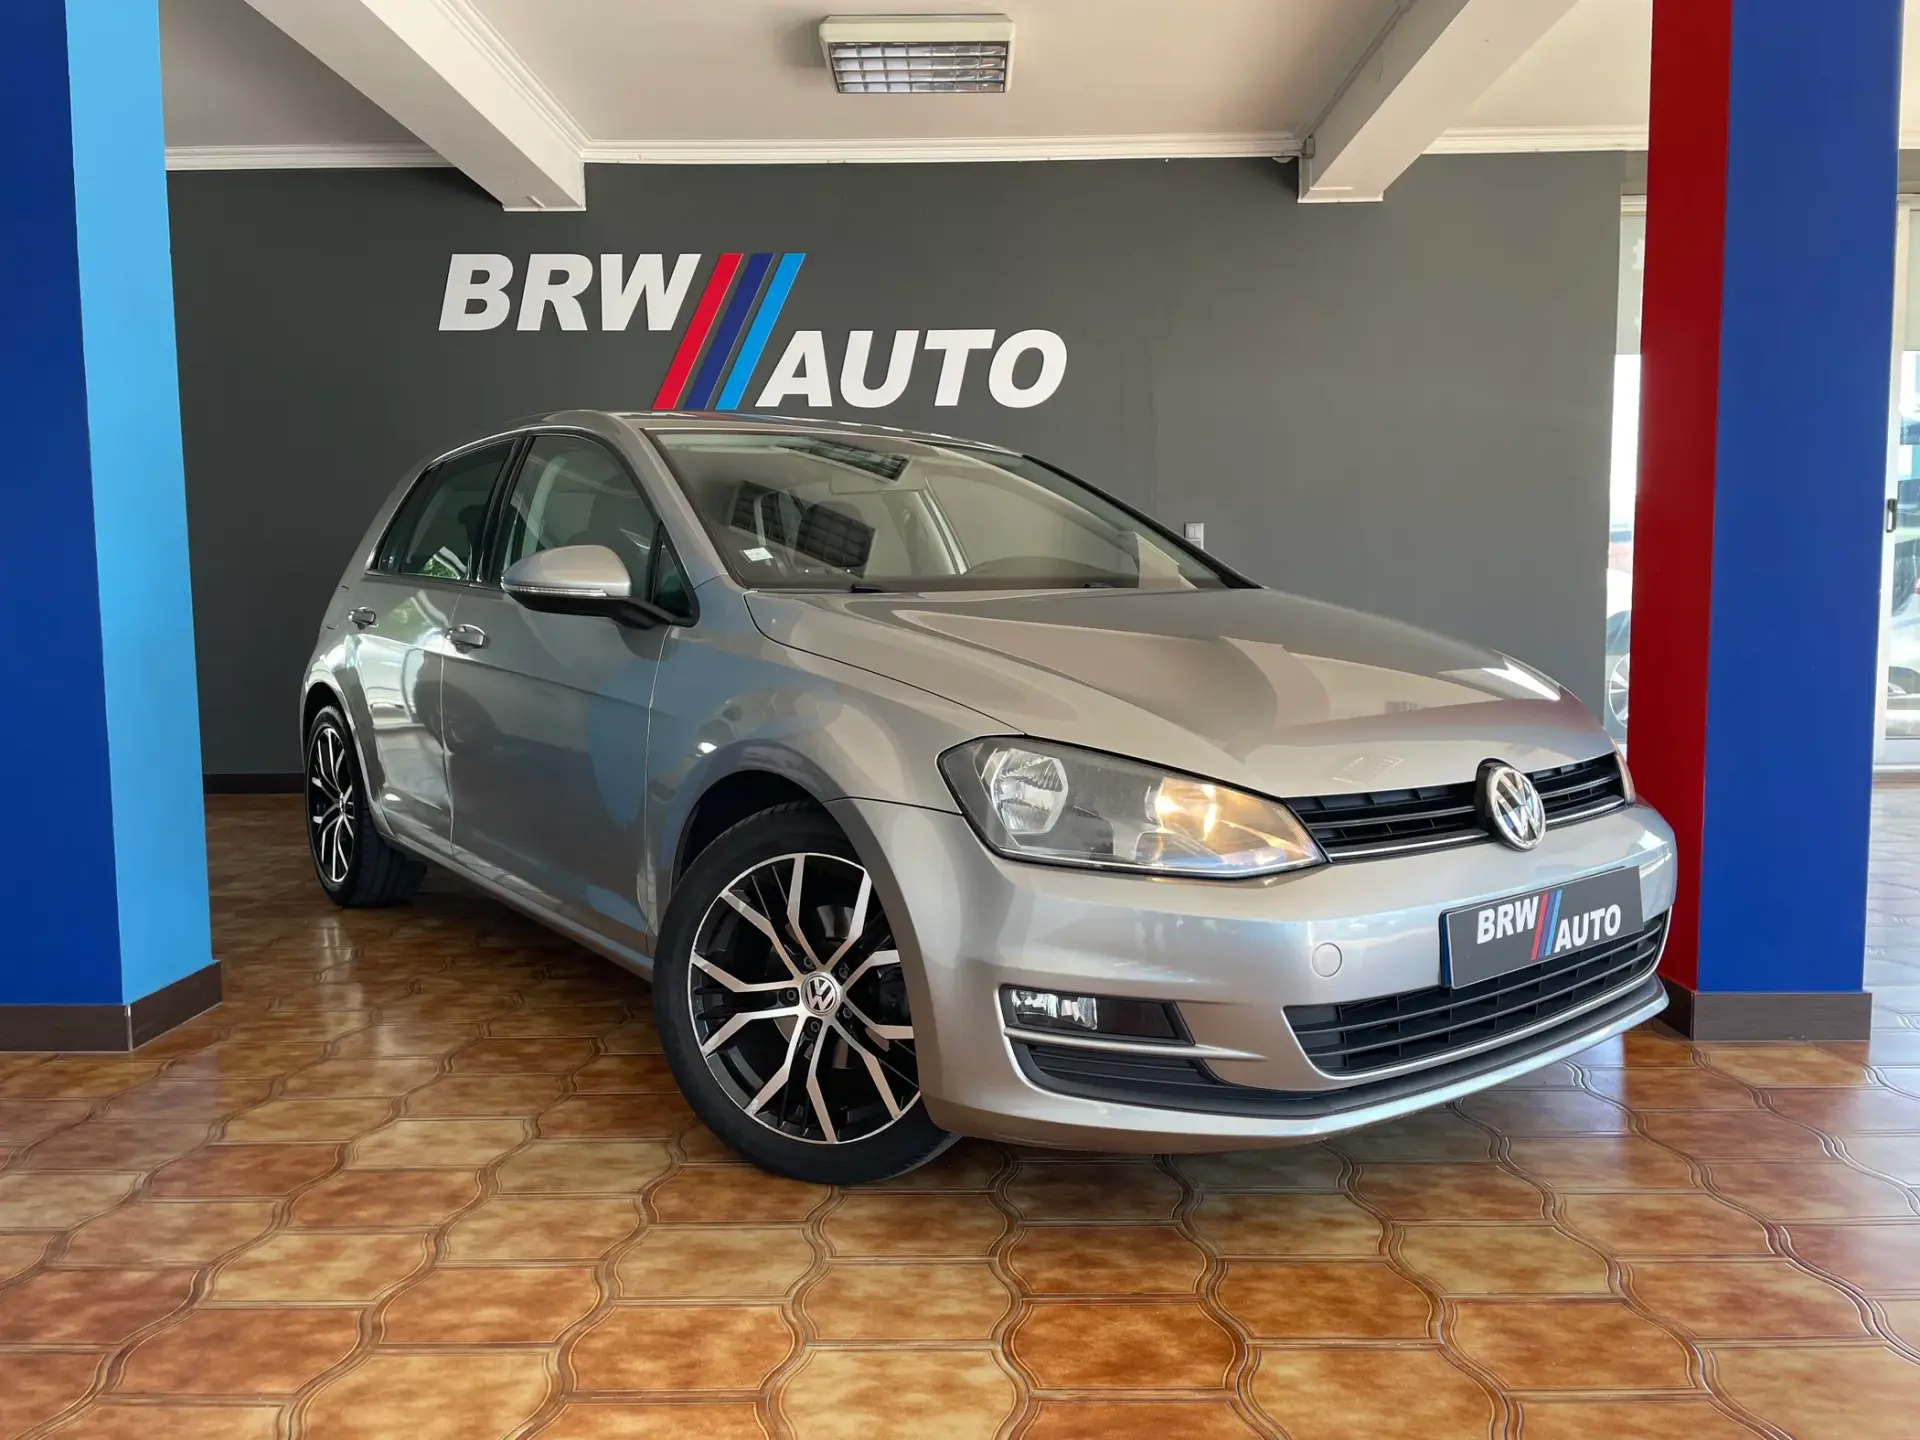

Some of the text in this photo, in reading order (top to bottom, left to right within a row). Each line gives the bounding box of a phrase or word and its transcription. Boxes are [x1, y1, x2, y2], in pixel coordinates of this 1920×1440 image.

[438, 253, 702, 331] BRW
[754, 328, 1068, 409] AUTO
[1491, 766, 1545, 847] VW
[1476, 895, 1540, 945] BRW
[1553, 903, 1622, 954] AUTO
[804, 974, 838, 1013] VW
